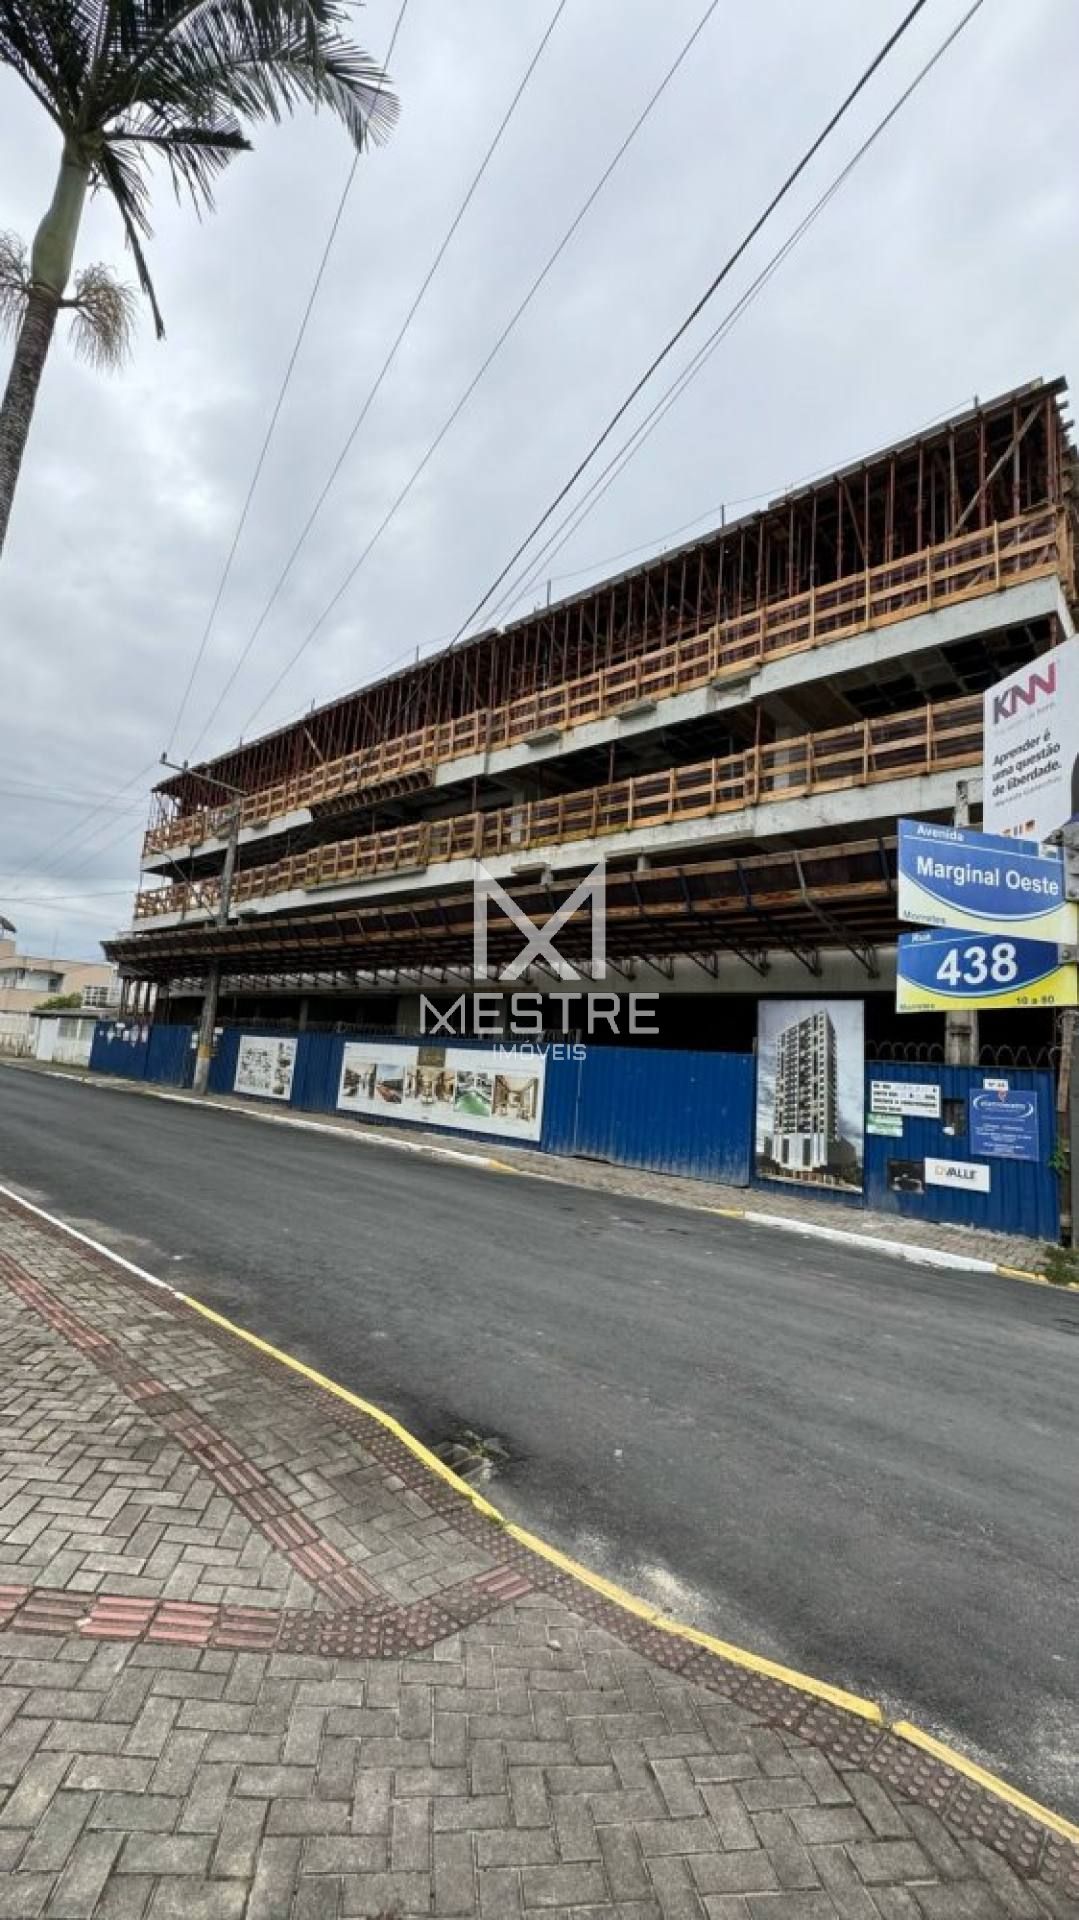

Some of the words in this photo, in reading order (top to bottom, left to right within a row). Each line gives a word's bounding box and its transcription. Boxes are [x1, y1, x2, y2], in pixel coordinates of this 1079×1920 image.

[994, 662, 1056, 724] KNN
[992, 764, 1014, 782] uma
[1015, 742, 1061, 773] questão
[993, 736, 1040, 766] Aprender
[1043, 728, 1051, 742] é
[992, 783, 1005, 797] de
[1007, 760, 1062, 791] liberdade.
[917, 824, 965, 841] Avenida
[916, 855, 1000, 886] Marginal
[1005, 869, 1059, 896] Oeste
[936, 942, 1018, 986] 438
